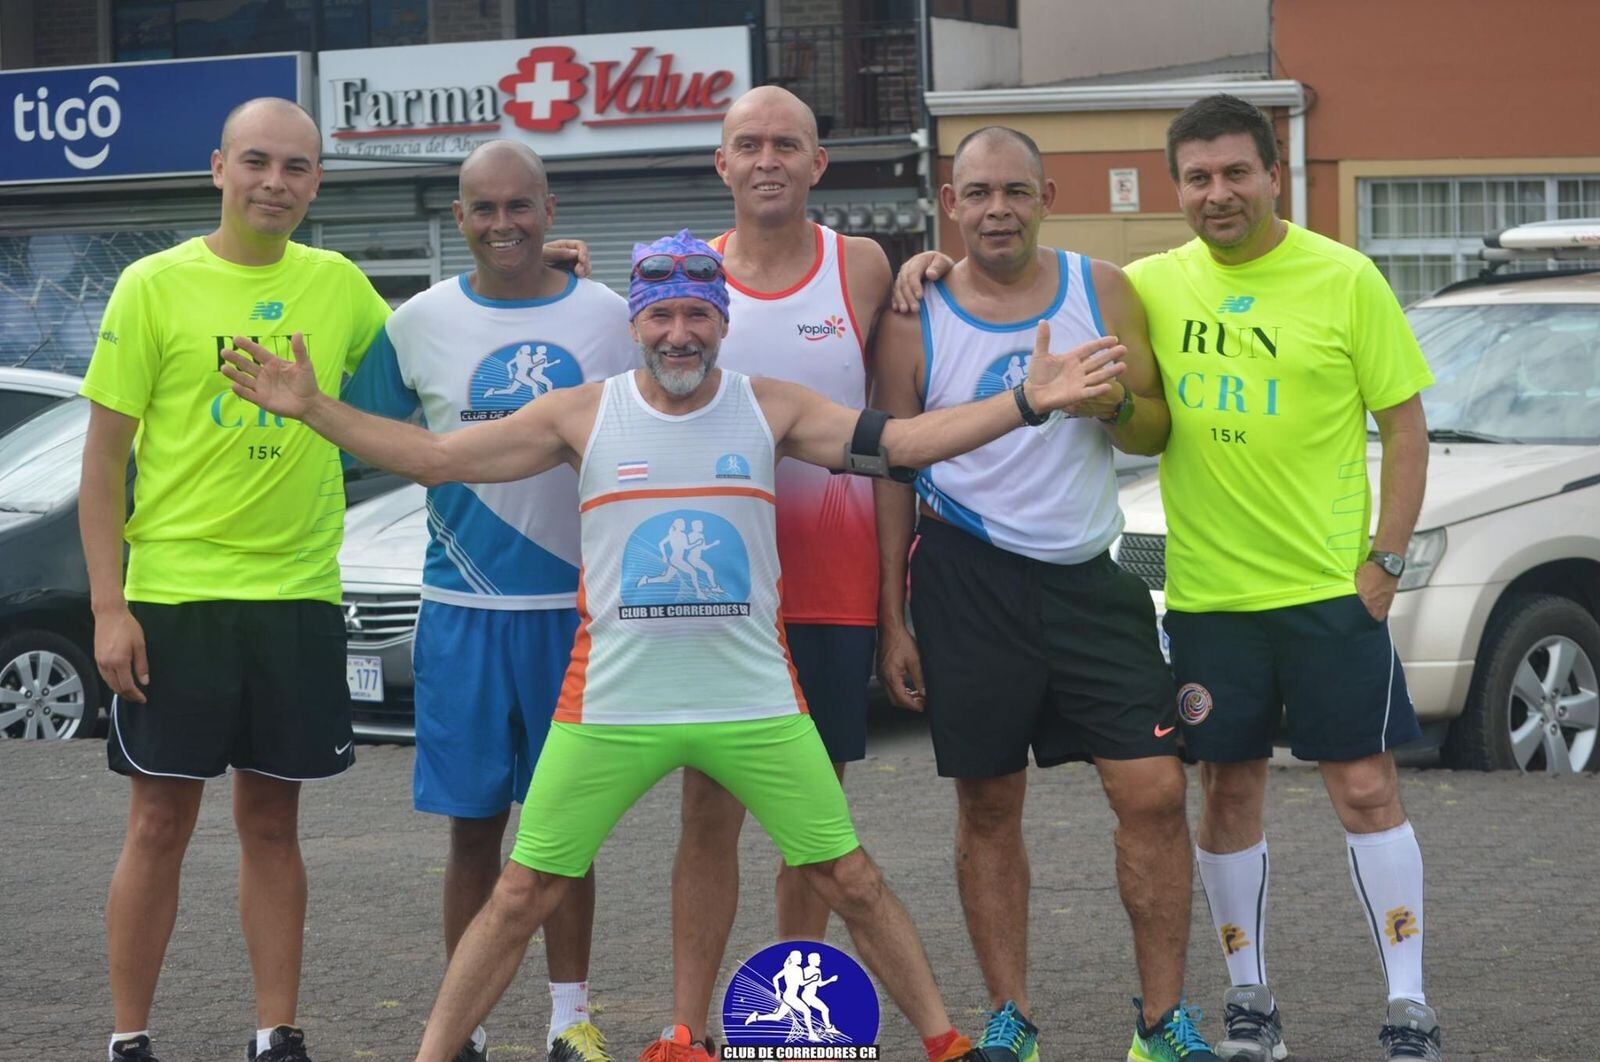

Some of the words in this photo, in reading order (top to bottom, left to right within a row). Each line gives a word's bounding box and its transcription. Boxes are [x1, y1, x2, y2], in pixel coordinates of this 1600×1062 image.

[329, 78, 501, 131] Farma
[589, 46, 734, 115] Value
[354, 140, 421, 156] Farmacia
[425, 135, 449, 153] del
[1179, 319, 1283, 359] RUN
[1178, 371, 1281, 416] CRI
[462, 411, 487, 420] CLUB
[1211, 427, 1247, 444] 15K
[247, 445, 282, 460] 15K
[621, 606, 648, 618] CLUB
[650, 605, 665, 617] DE
[667, 604, 739, 617] CORREDORES
